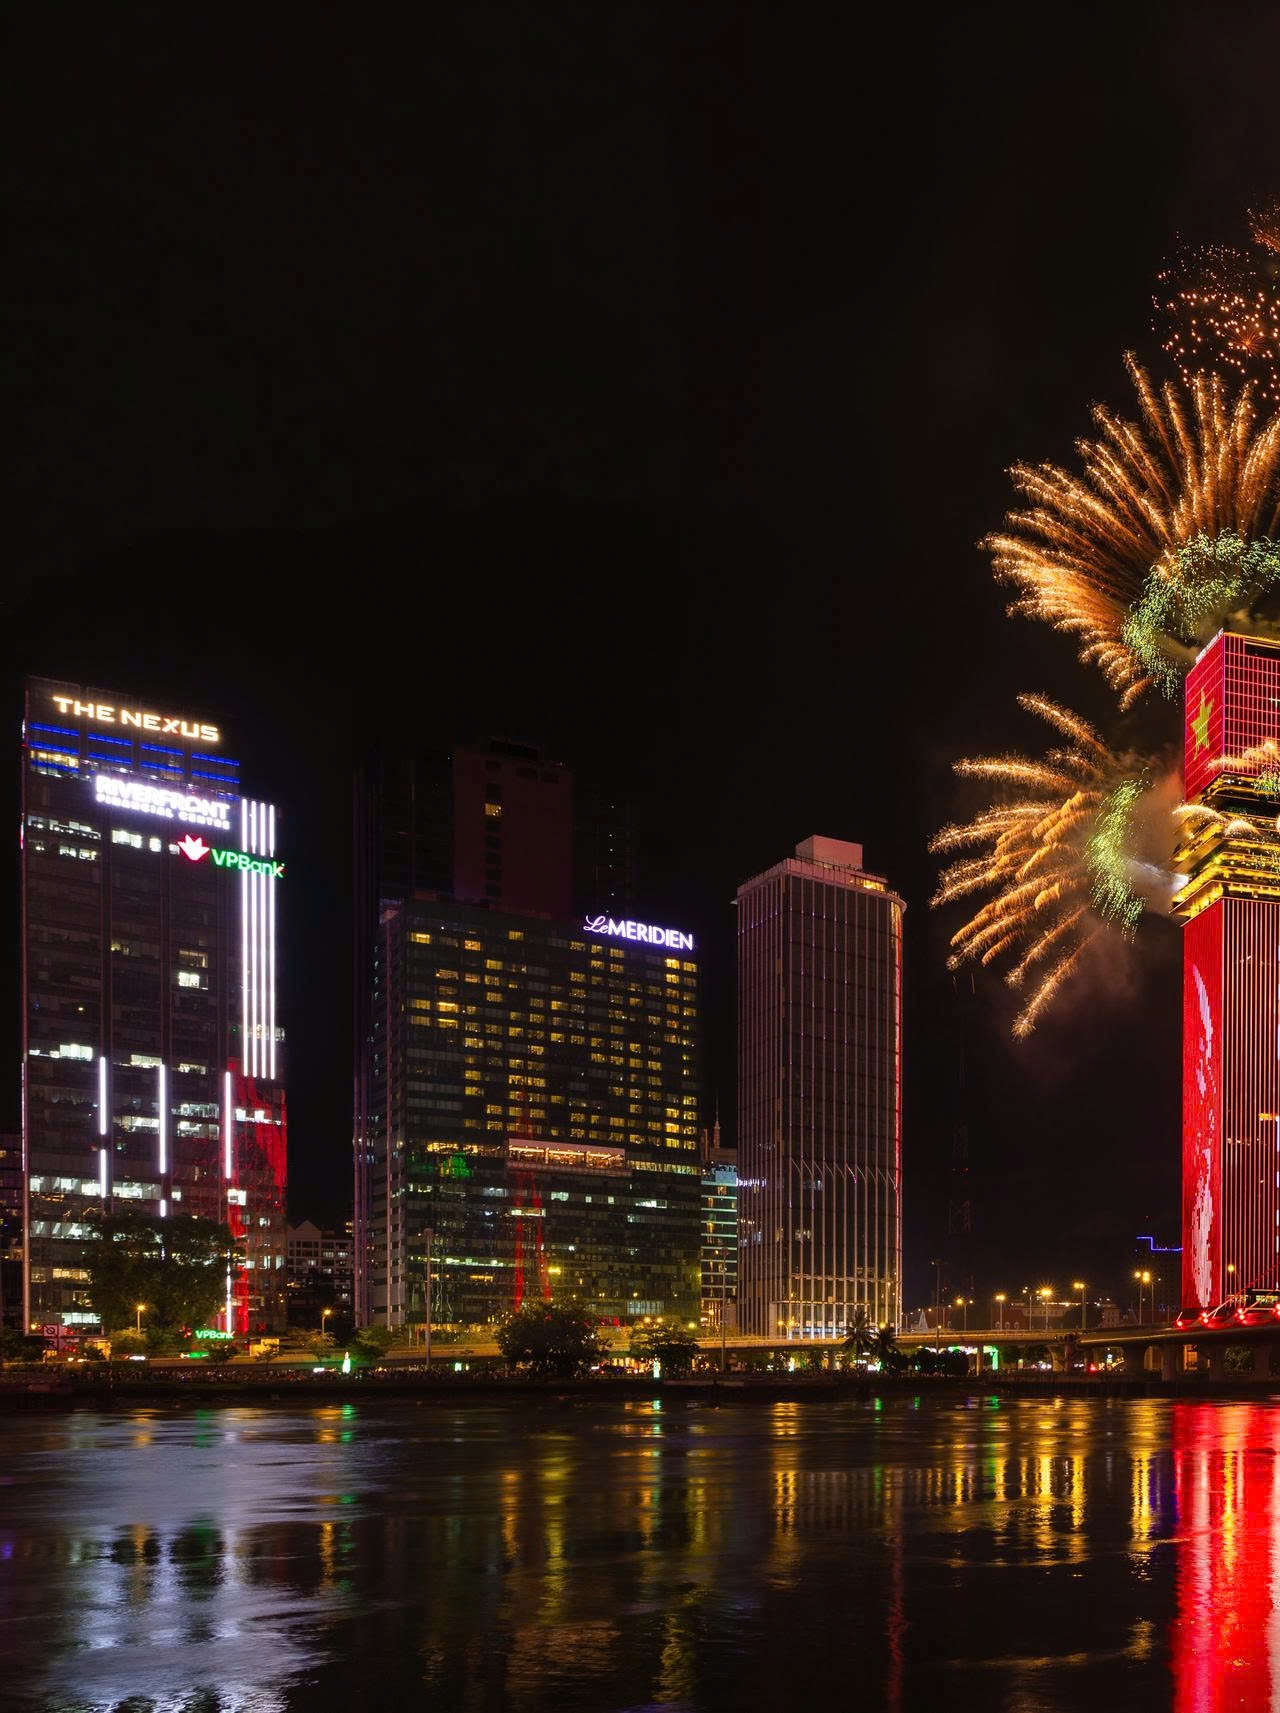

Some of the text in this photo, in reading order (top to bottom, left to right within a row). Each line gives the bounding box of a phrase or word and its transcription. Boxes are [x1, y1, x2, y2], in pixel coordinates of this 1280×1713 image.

[53, 696, 219, 742] THE NEXUS
[96, 775, 230, 820] RIVERFRONT
[96, 793, 174, 819] FINANCIAL
[211, 848, 285, 879] VPBank
[195, 1330, 235, 1340] VPBank
